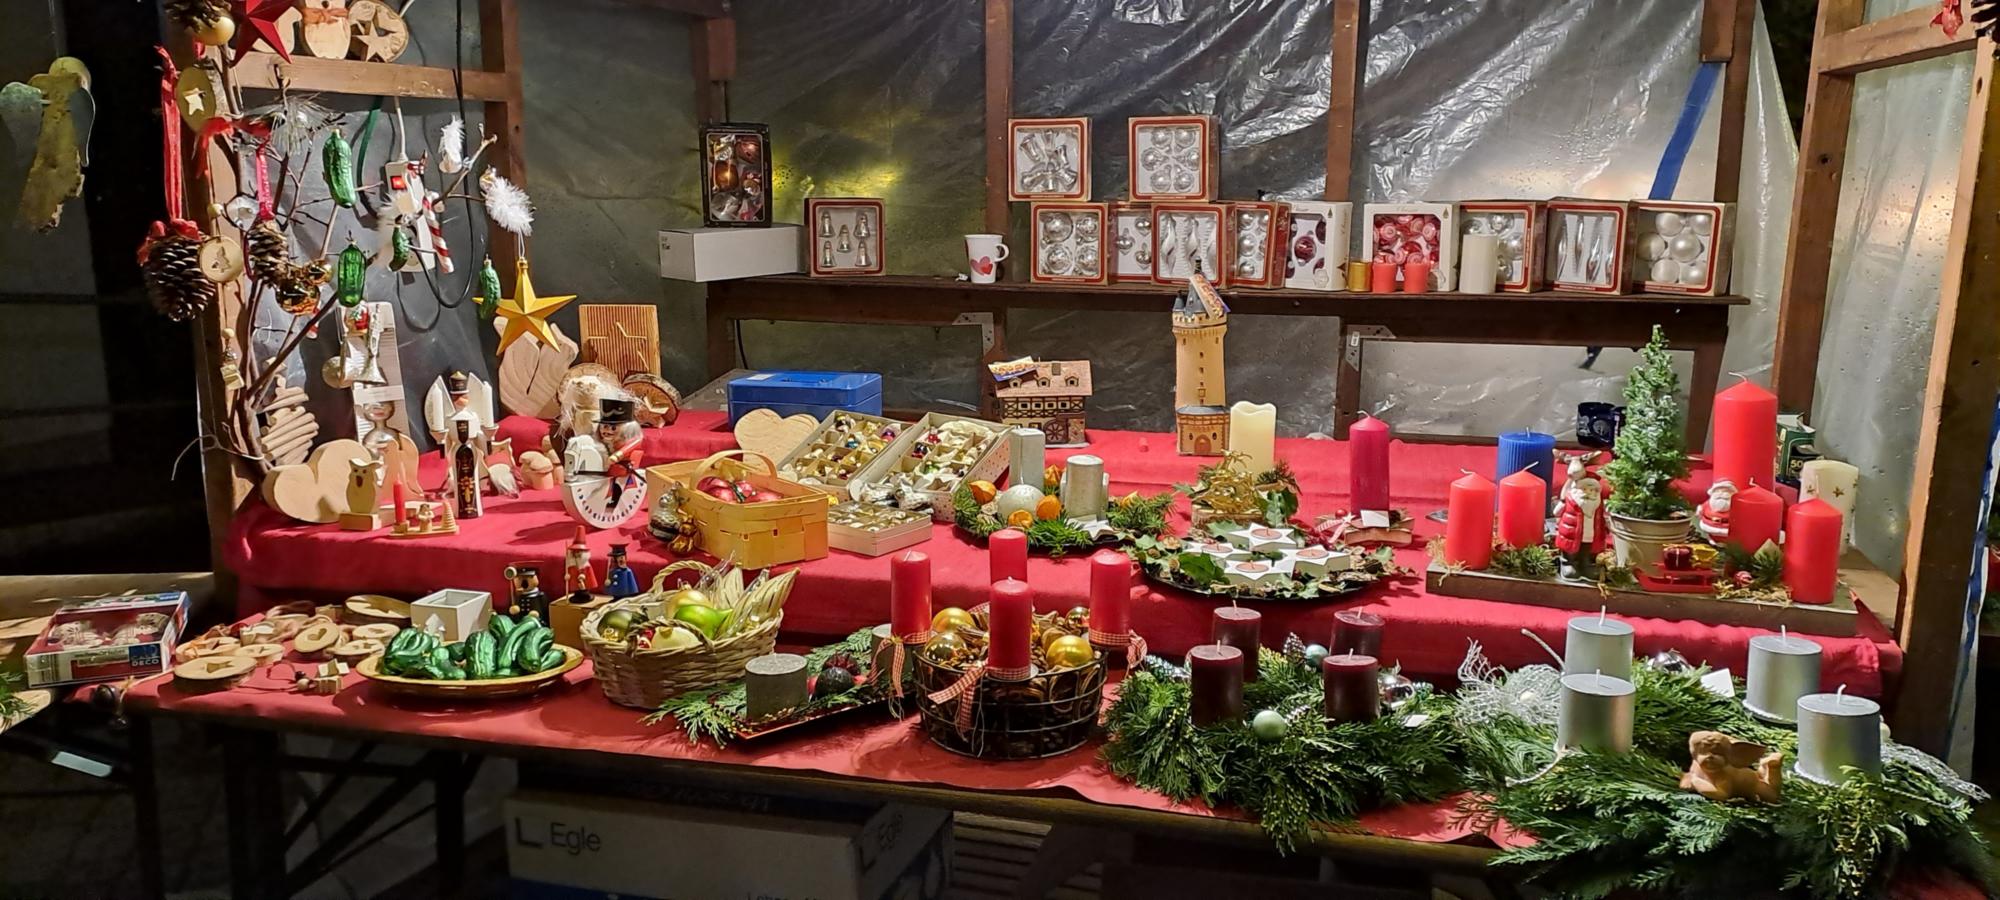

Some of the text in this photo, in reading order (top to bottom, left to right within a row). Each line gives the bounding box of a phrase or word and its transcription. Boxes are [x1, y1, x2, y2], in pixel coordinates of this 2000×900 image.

[1790, 460, 1804, 468] 50
[132, 658, 160, 667] DECO
[550, 822, 601, 856] Egle
